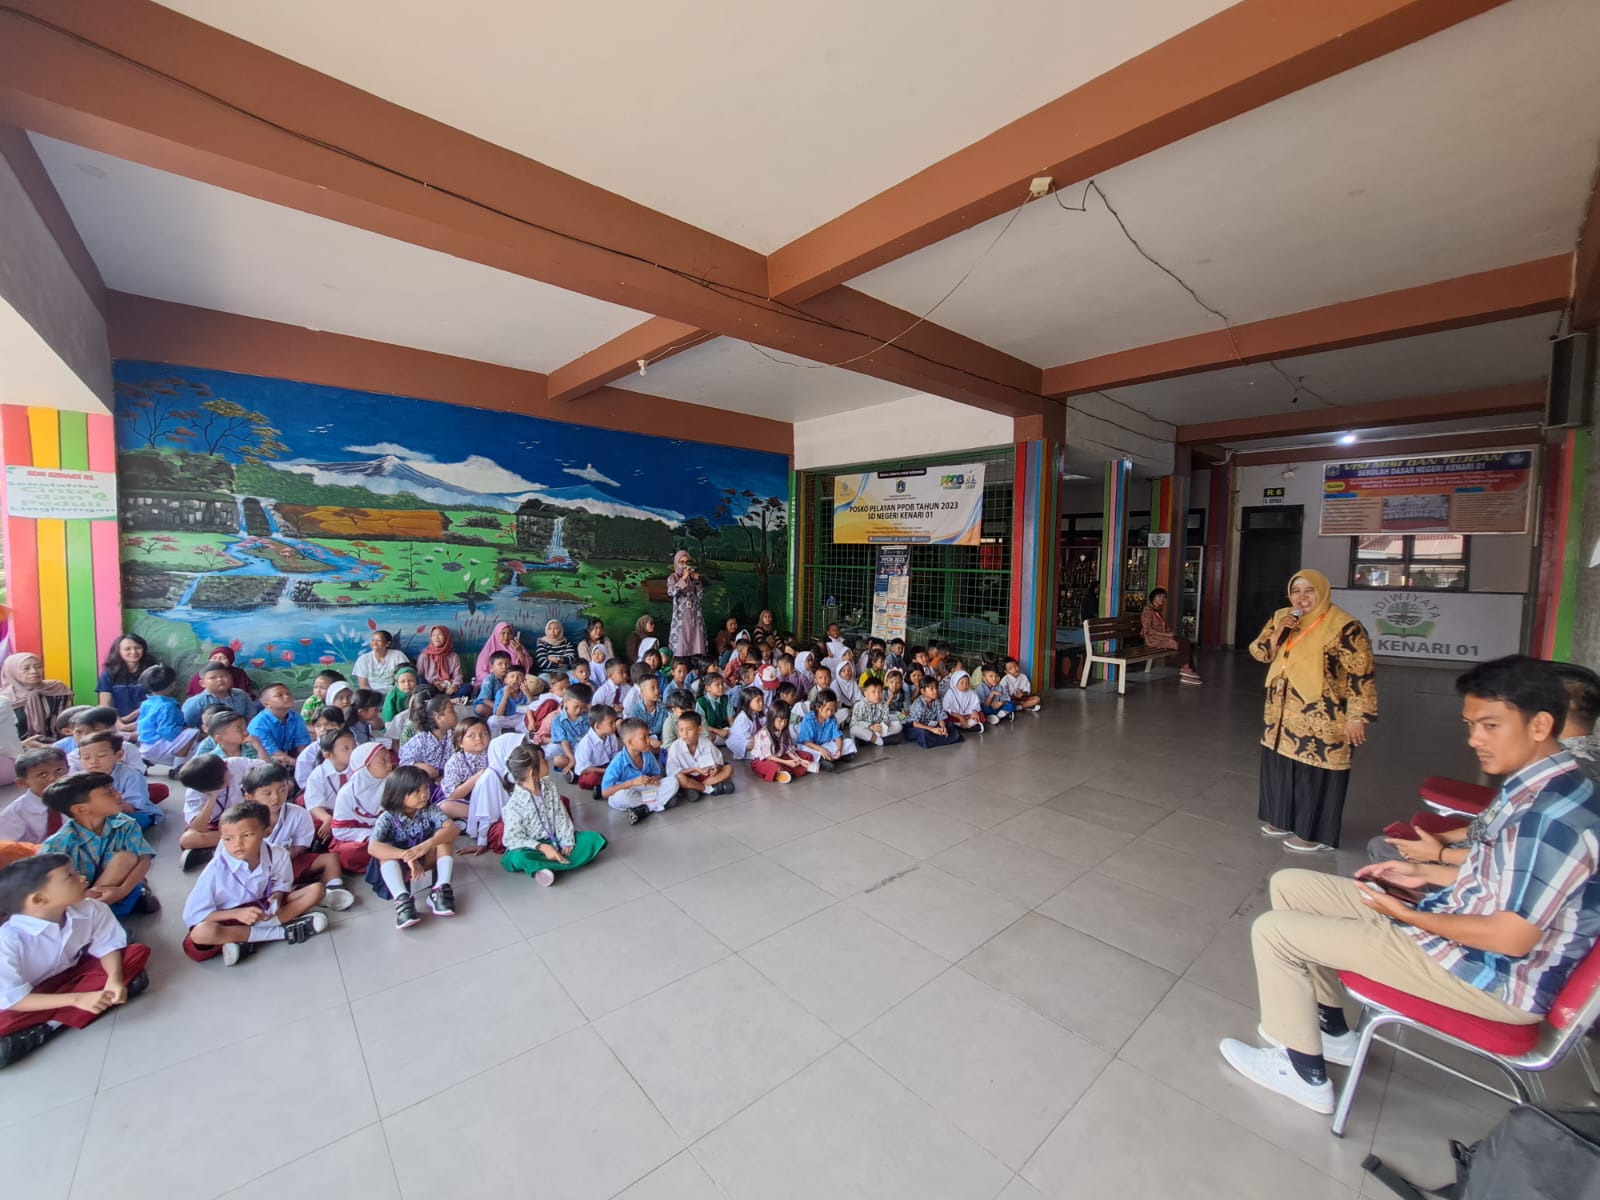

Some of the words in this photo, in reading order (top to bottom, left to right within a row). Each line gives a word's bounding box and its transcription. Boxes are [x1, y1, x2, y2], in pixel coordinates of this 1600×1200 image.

[850, 504, 869, 513] POSKO
[870, 504, 896, 512] PELAYAN
[898, 503, 915, 512] PPDB
[916, 502, 940, 510] TAHUN
[941, 502, 958, 510] 2023
[868, 512, 876, 520] SD
[876, 512, 899, 520] NEGERI
[926, 511, 934, 519] 01
[1371, 593, 1440, 620] ADIWIYATA
[1378, 639, 1450, 654] KENARI
[1456, 644, 1479, 656] 01
